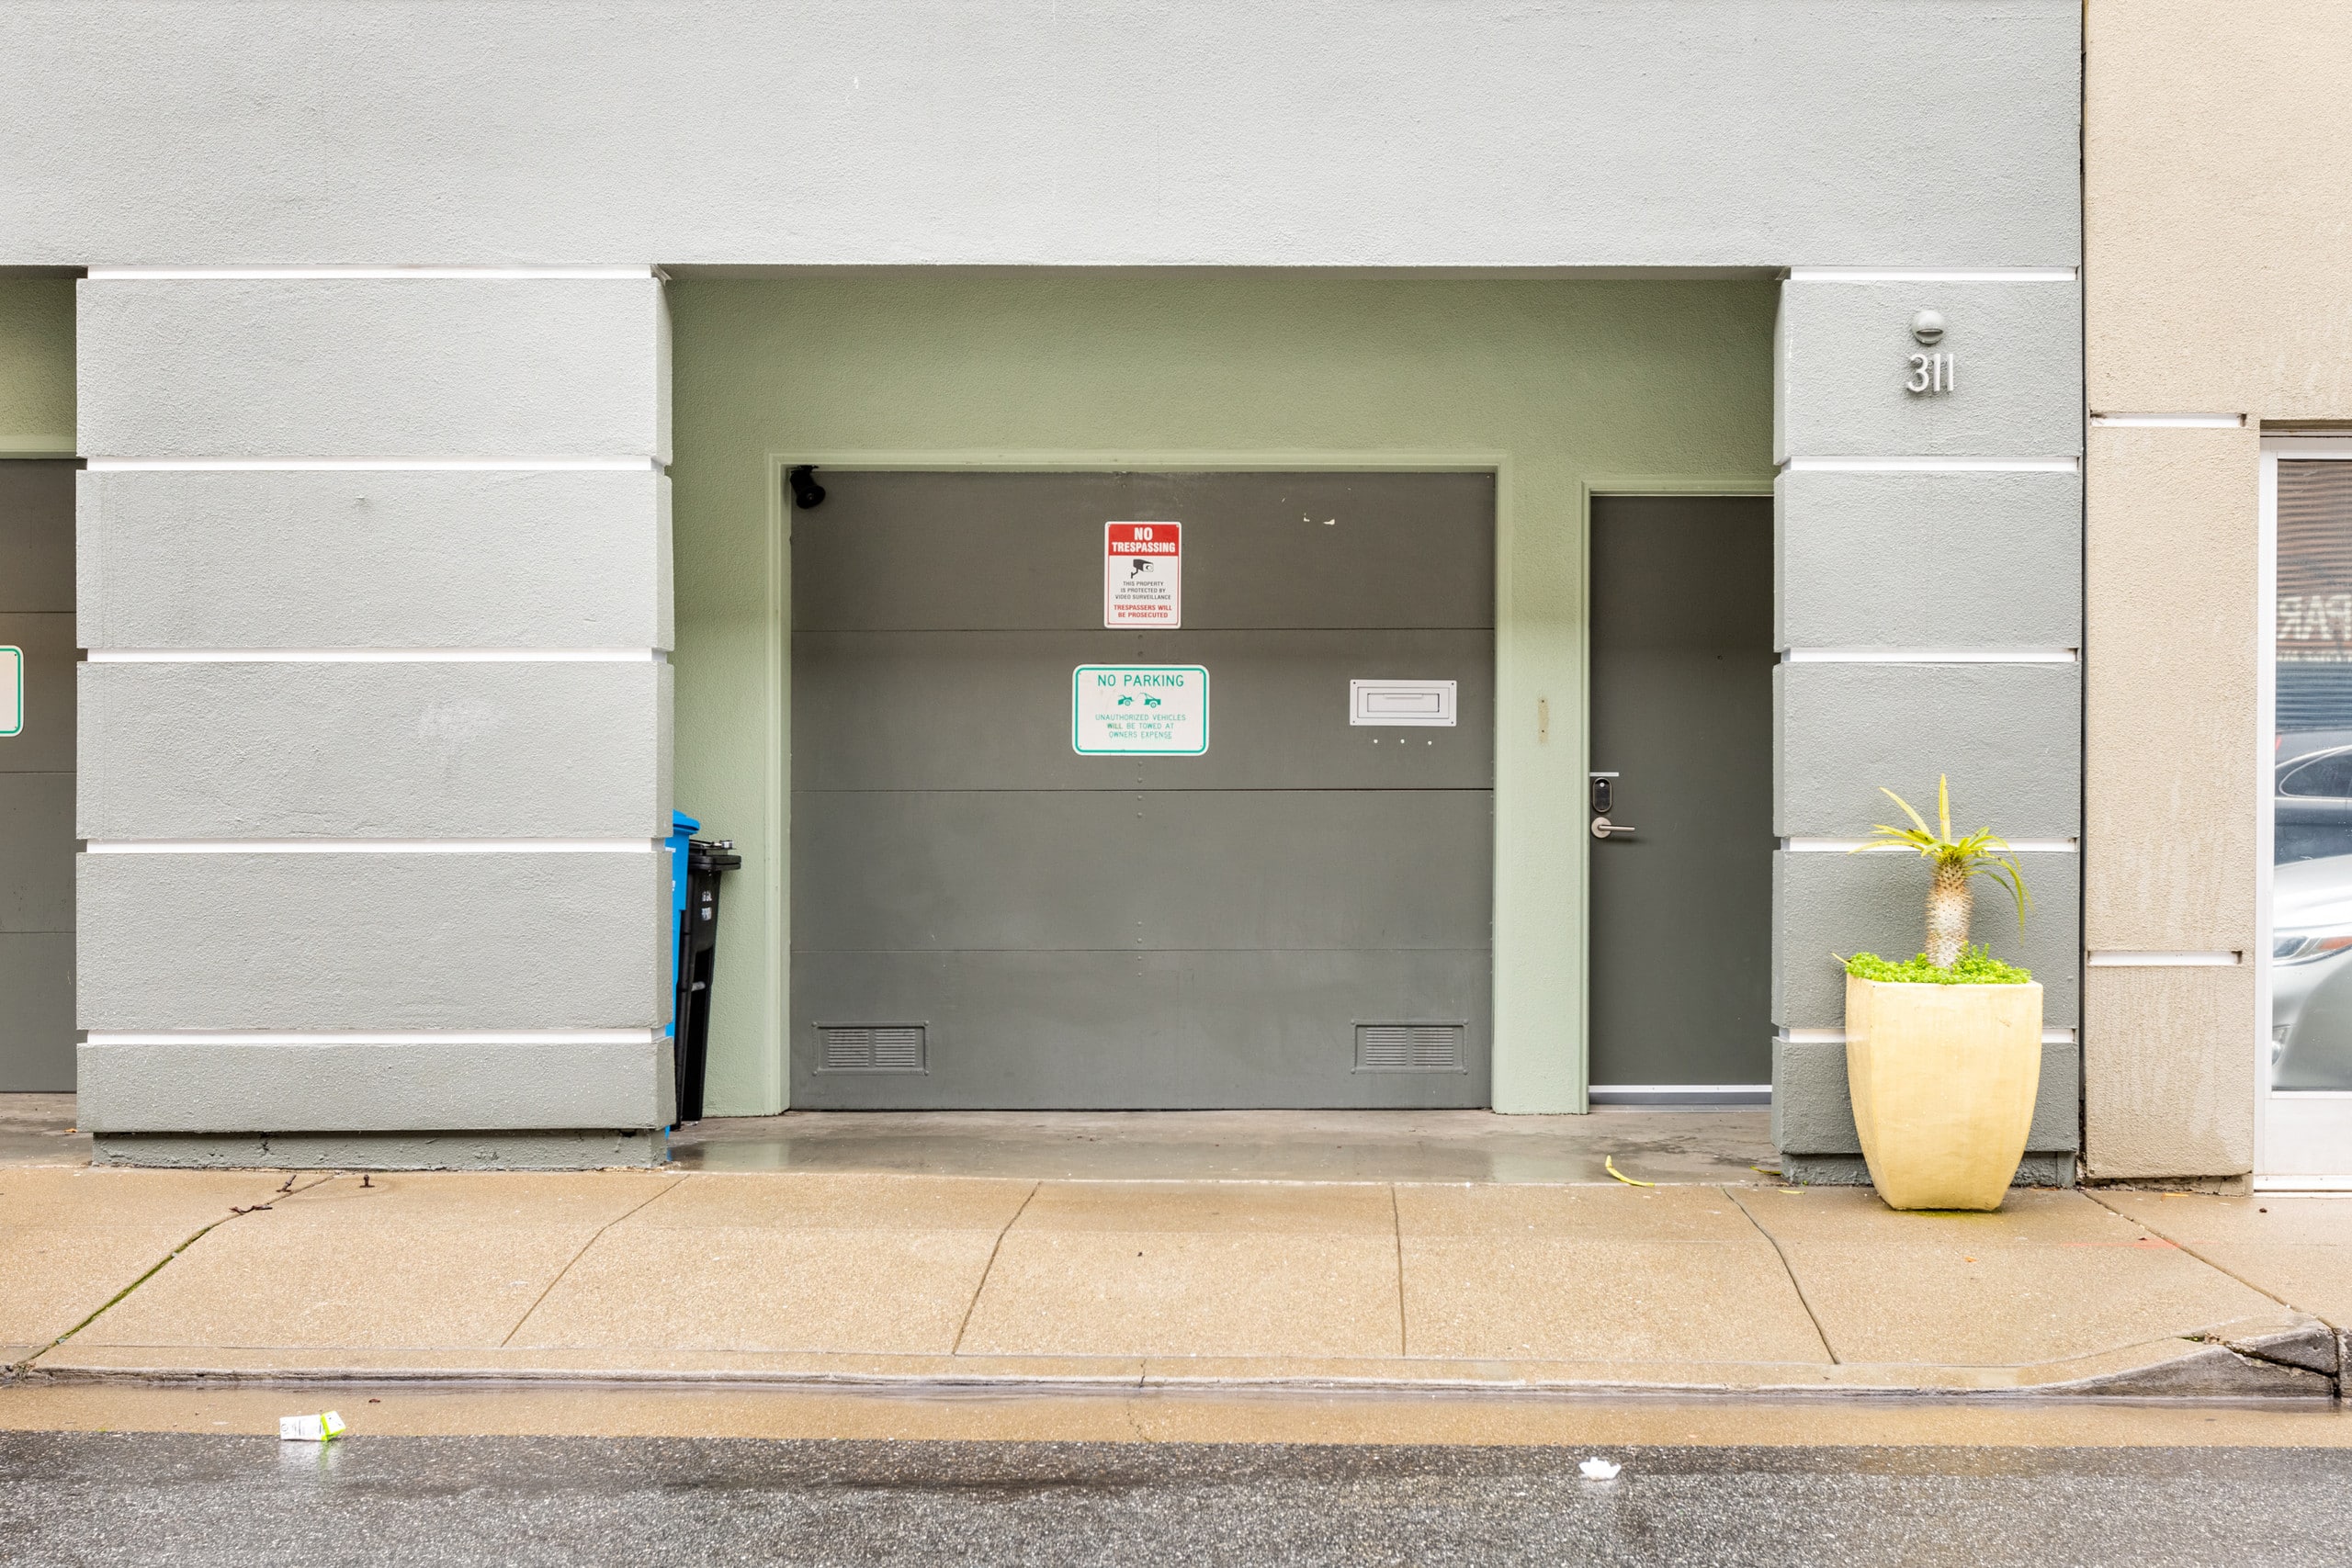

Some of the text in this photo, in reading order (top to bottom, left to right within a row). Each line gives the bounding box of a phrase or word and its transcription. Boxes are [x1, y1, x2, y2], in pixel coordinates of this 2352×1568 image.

[1906, 353, 1954, 393] 311
[1134, 526, 1153, 541] NO
[1112, 541, 1176, 553] TRESPASSING
[1097, 674, 1184, 687] NO PARKING
[1140, 731, 1172, 739] EXPENSE
